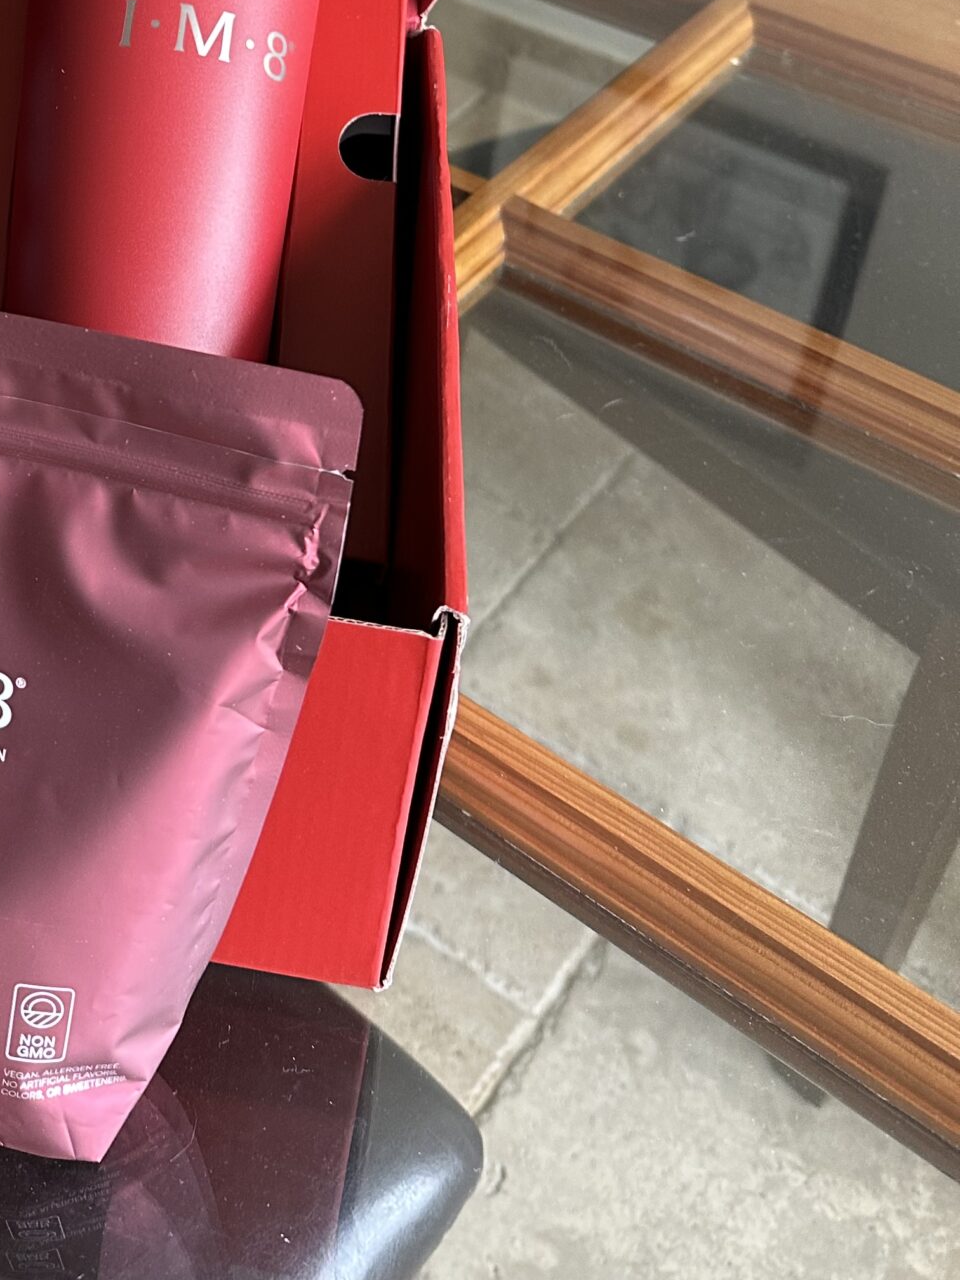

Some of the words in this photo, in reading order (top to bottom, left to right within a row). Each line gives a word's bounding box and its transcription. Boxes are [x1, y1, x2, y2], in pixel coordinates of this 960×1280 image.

[19, 1033, 56, 1048] NON
[16, 1045, 56, 1059] GMO
[42, 1065, 94, 1076] ALLERGEN
[1, 1078, 18, 1089] NO
[19, 1074, 71, 1090] ARTIFICIAL
[46, 1085, 62, 1098] OR
